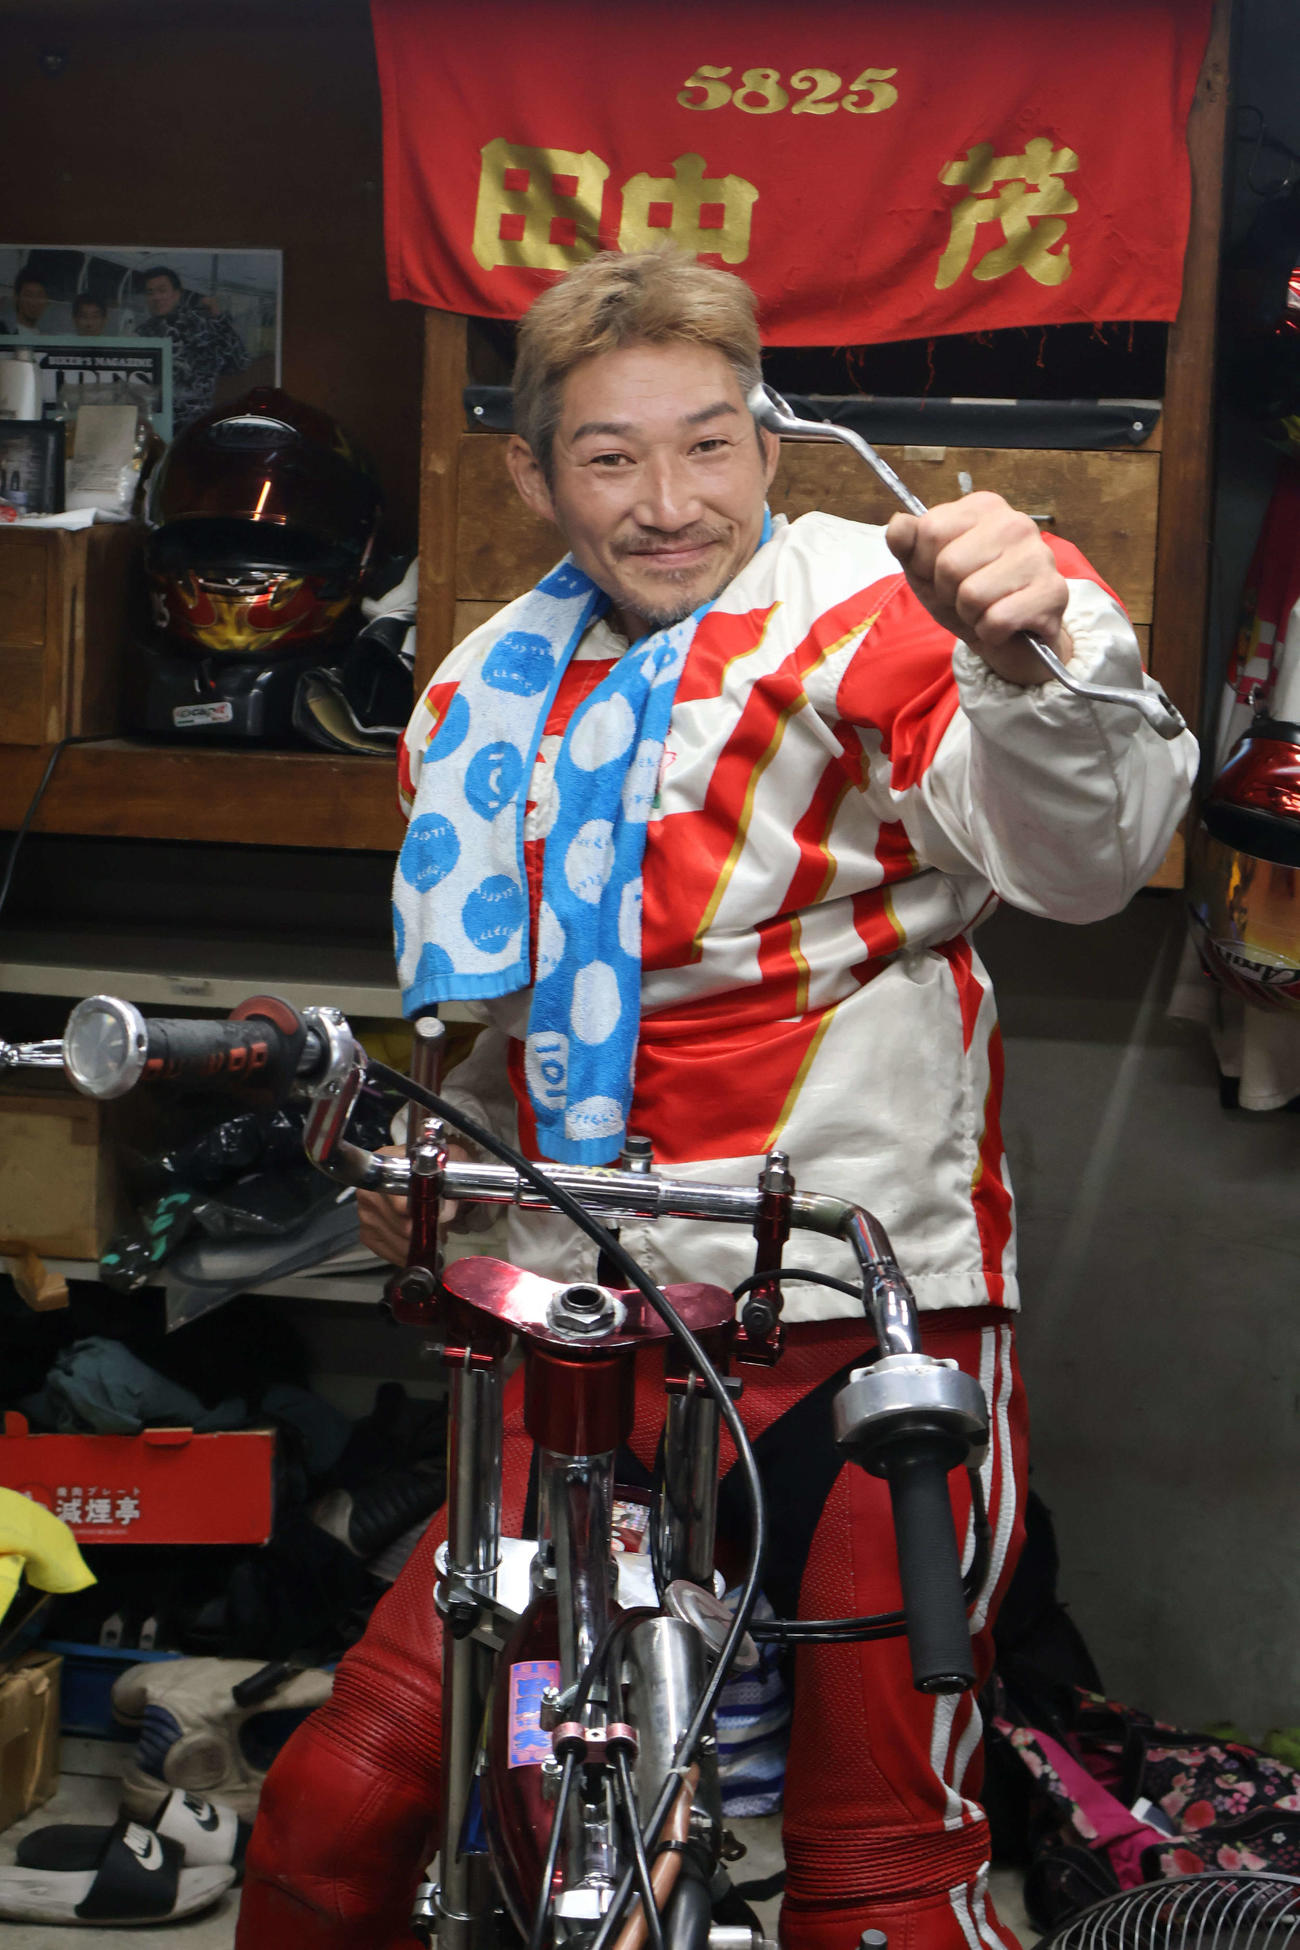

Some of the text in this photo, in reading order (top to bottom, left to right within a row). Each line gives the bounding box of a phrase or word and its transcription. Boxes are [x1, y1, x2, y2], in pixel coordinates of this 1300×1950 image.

[677, 65, 899, 115] 5825
[473, 136, 1081, 290] 田中 茂
[94, 356, 154, 368] MAGAZINE
